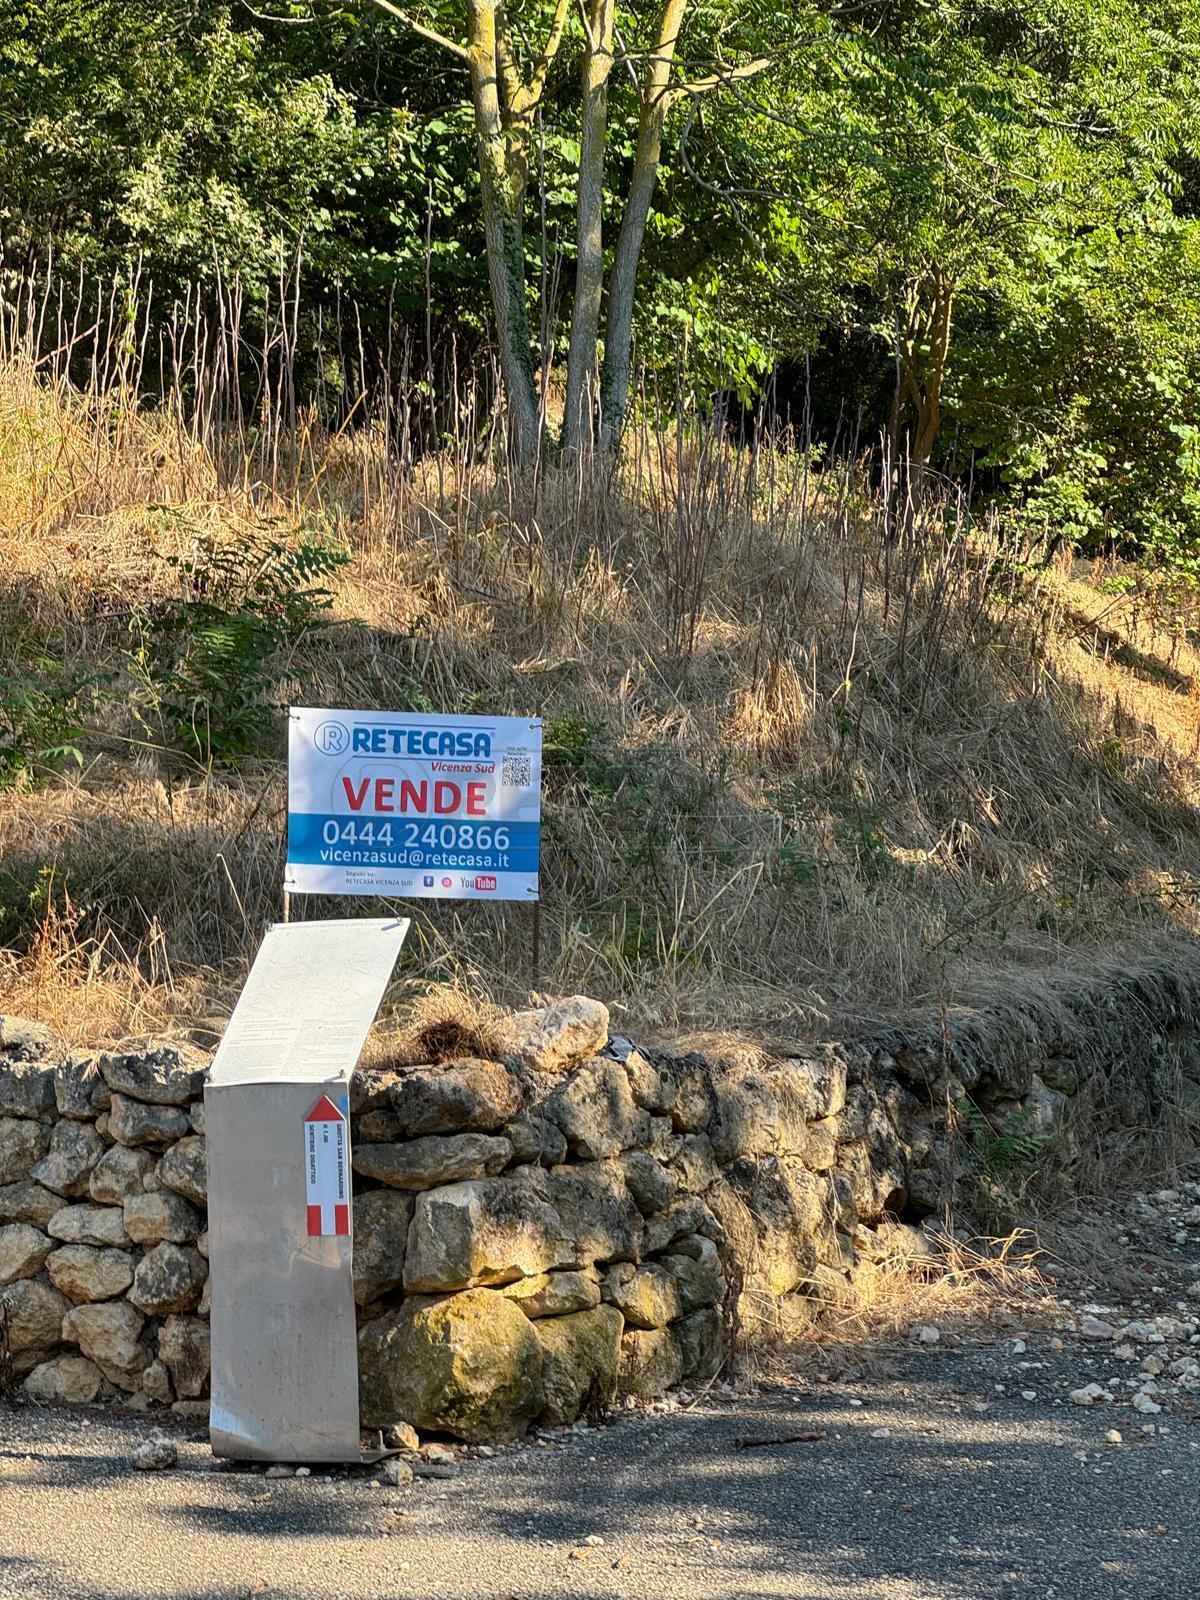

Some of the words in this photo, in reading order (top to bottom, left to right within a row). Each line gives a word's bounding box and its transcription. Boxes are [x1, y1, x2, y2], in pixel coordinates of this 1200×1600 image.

[352, 728, 491, 758] RETECASA
[430, 761, 472, 773] Vicenza
[475, 762, 495, 774] Sud
[342, 777, 487, 815] VENDE
[322, 820, 394, 848] 0444
[405, 823, 510, 850] 240866
[320, 848, 510, 868] vicenzasud@retecasa.it
